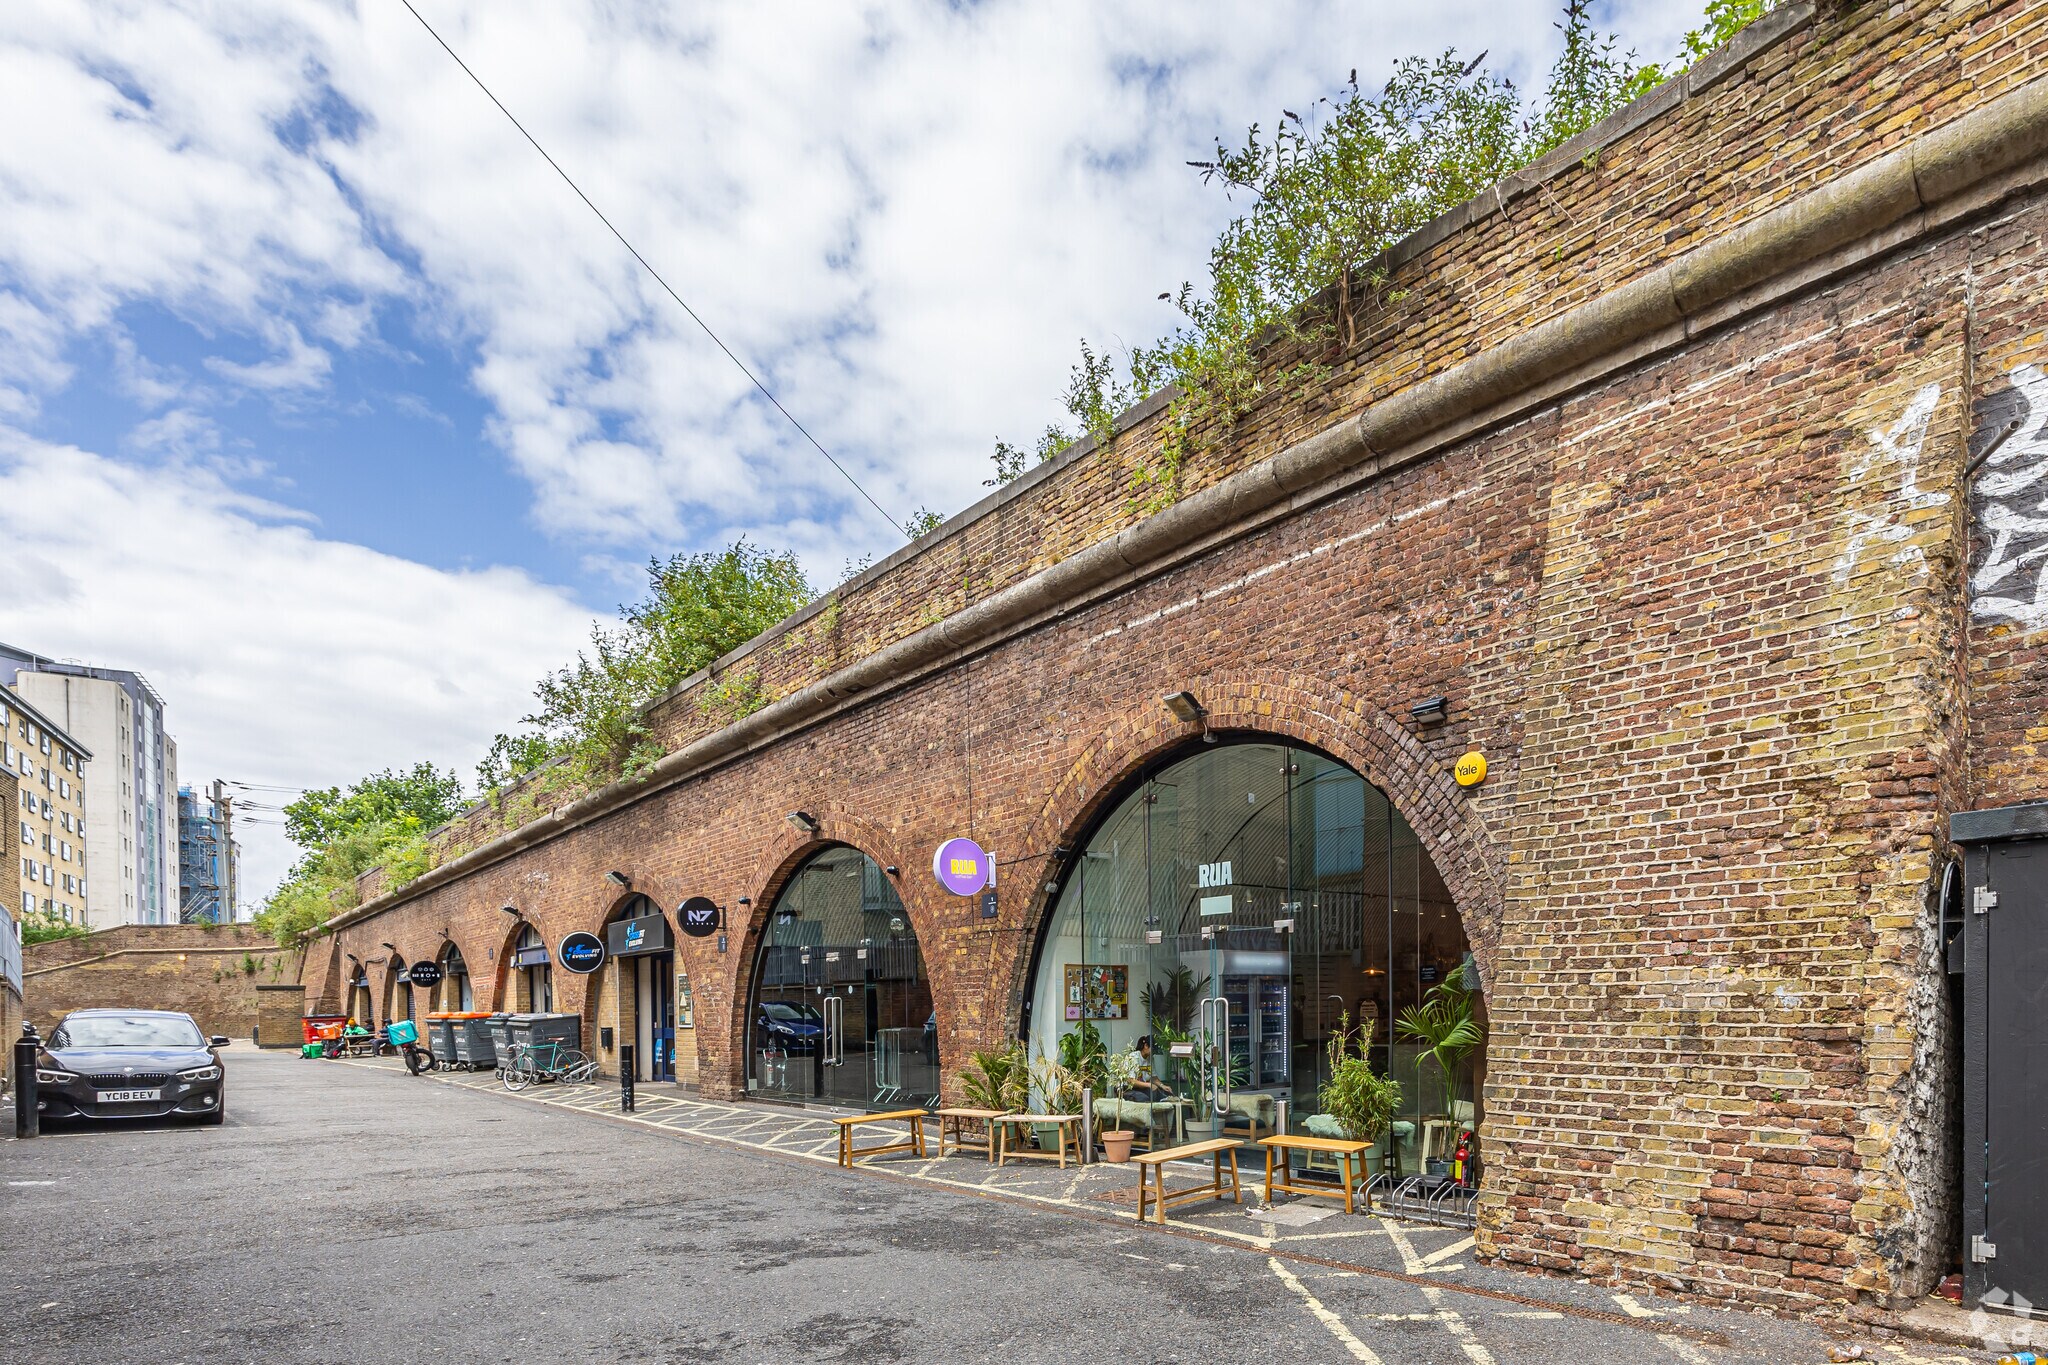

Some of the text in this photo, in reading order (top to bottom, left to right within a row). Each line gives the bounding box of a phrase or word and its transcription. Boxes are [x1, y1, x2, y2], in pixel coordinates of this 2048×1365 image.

[1457, 764, 1477, 776] Yale
[950, 859, 977, 875] RUA
[1199, 861, 1232, 888] RUA
[687, 909, 713, 922] N7
[105, 1091, 154, 1100] YC18 EEV
